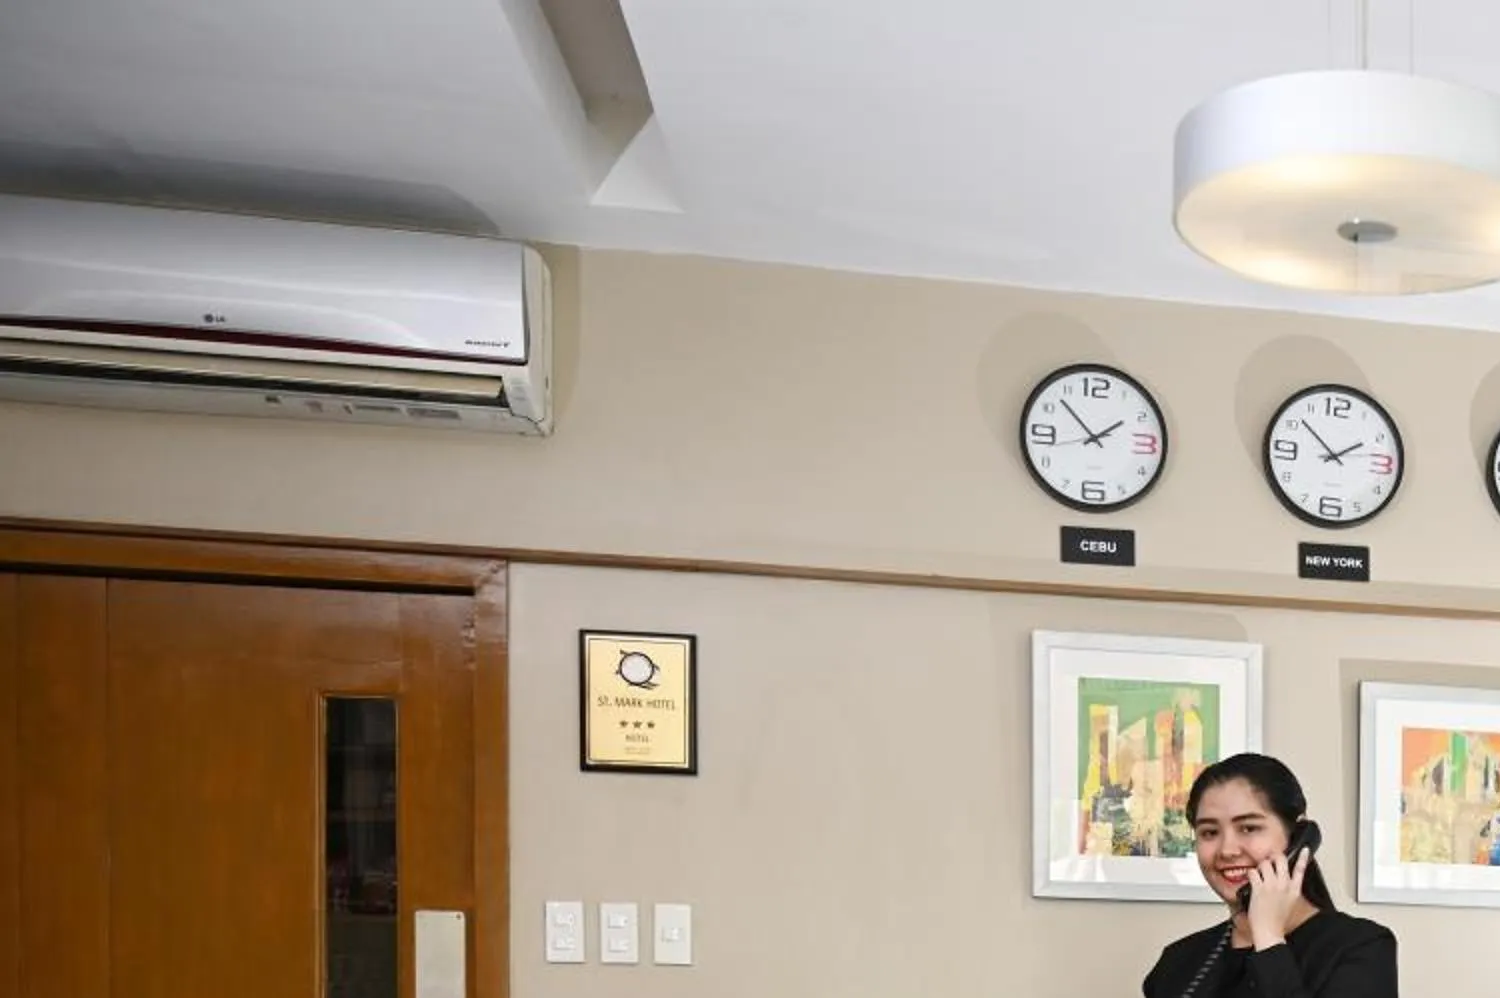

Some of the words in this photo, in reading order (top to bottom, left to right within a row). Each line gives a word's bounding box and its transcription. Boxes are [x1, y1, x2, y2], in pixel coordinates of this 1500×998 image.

[1081, 376, 1111, 399] 12
[1324, 396, 1352, 419] 12
[1031, 423, 1056, 446] 9
[1131, 432, 1157, 455] 3
[1274, 439, 1298, 461] 9
[1368, 453, 1393, 475] 3
[1081, 480, 1106, 502] 6
[1319, 496, 1342, 517] 6
[1079, 540, 1118, 553] CEBU
[1305, 555, 1331, 567] NEW
[1332, 557, 1364, 569] YORK
